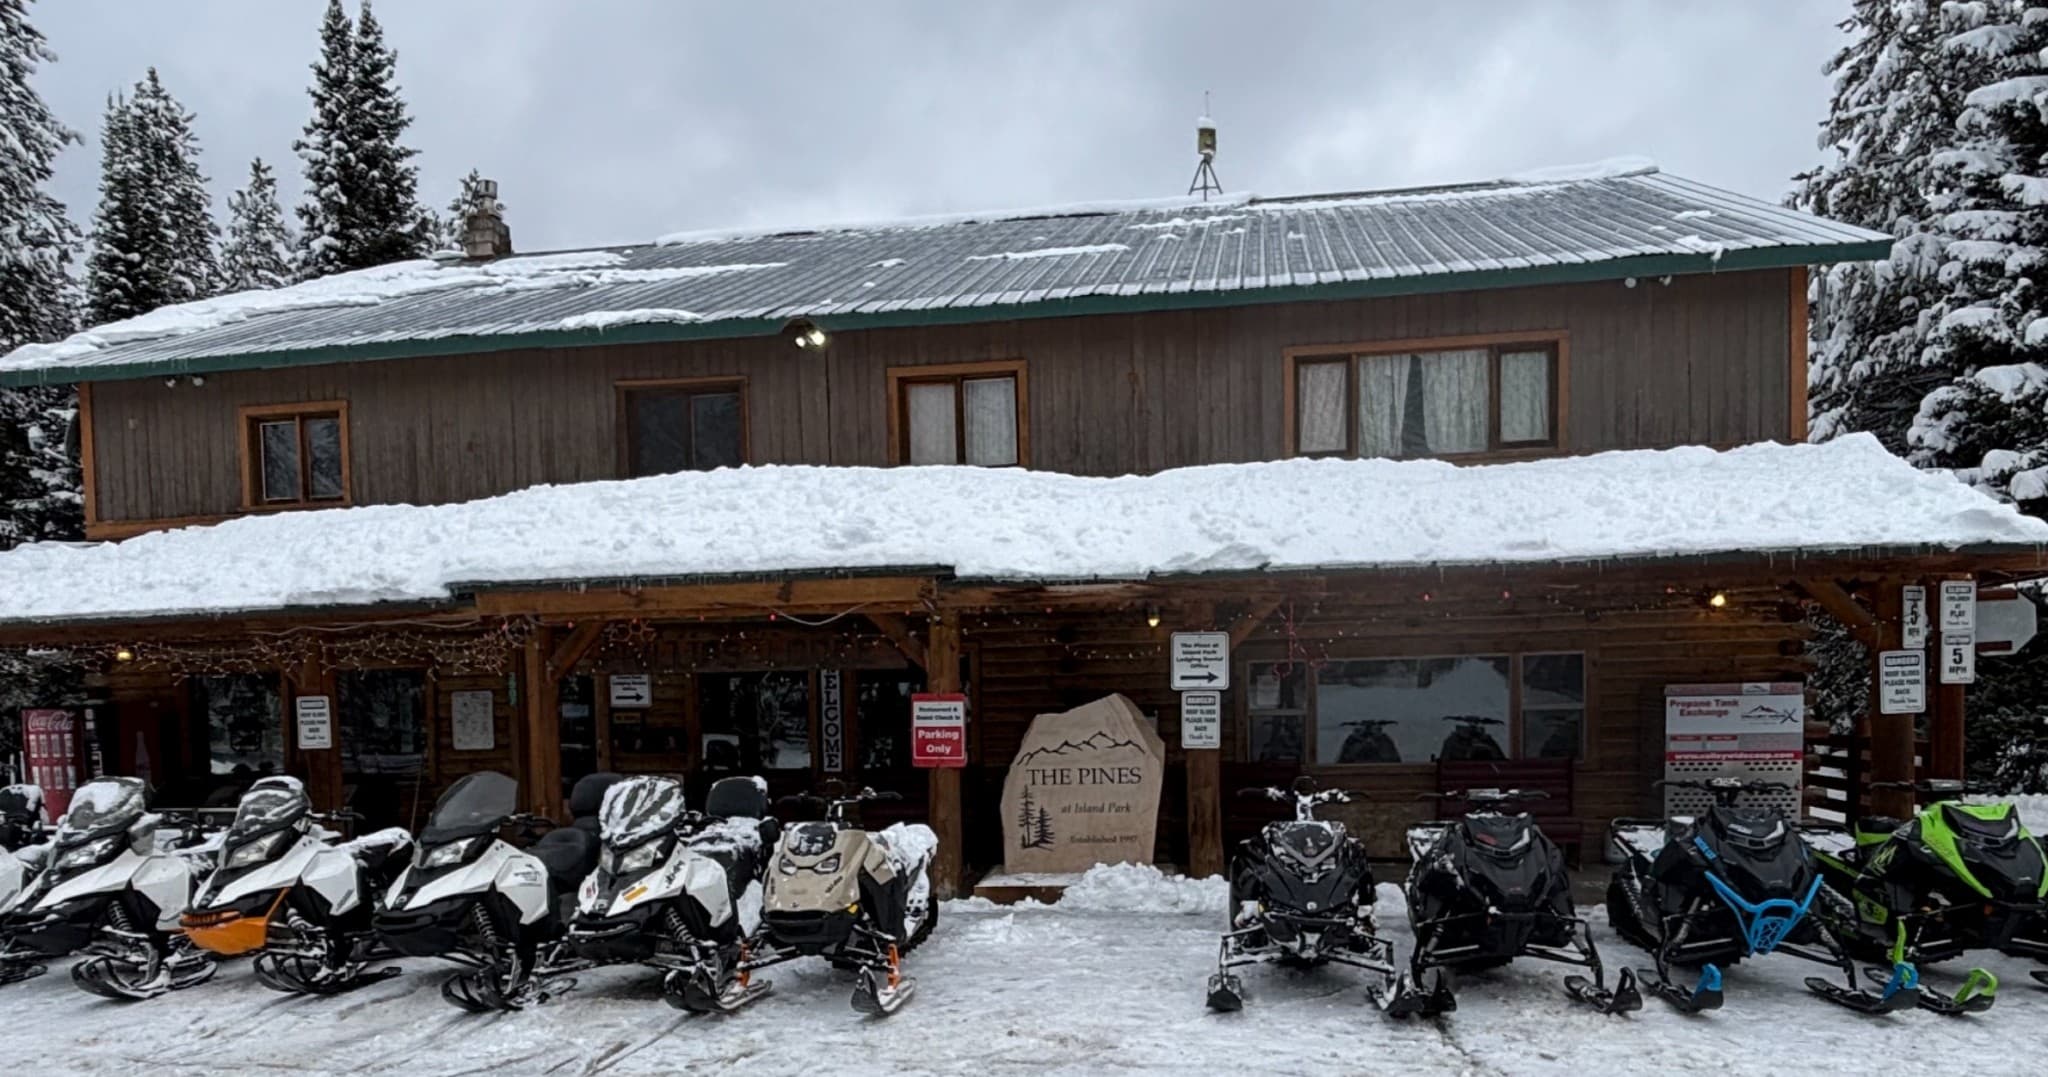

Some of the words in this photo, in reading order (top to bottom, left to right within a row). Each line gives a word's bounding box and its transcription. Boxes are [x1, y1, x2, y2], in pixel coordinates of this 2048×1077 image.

[1952, 648, 1963, 665] 5
[1949, 666, 1967, 674] MPH
[1670, 699, 1712, 708] Propane
[1714, 698, 1739, 706] Tank
[1679, 708, 1729, 717] Exchange
[824, 672, 840, 768] ELCOME
[918, 729, 959, 740] Parking
[926, 744, 951, 755] Only
[1026, 769, 1072, 785] THE
[1078, 767, 1142, 785] PINES
[1061, 804, 1071, 813] at
[1075, 802, 1104, 813] Island
[1108, 802, 1131, 813] Park
[1070, 834, 1117, 844] Established
